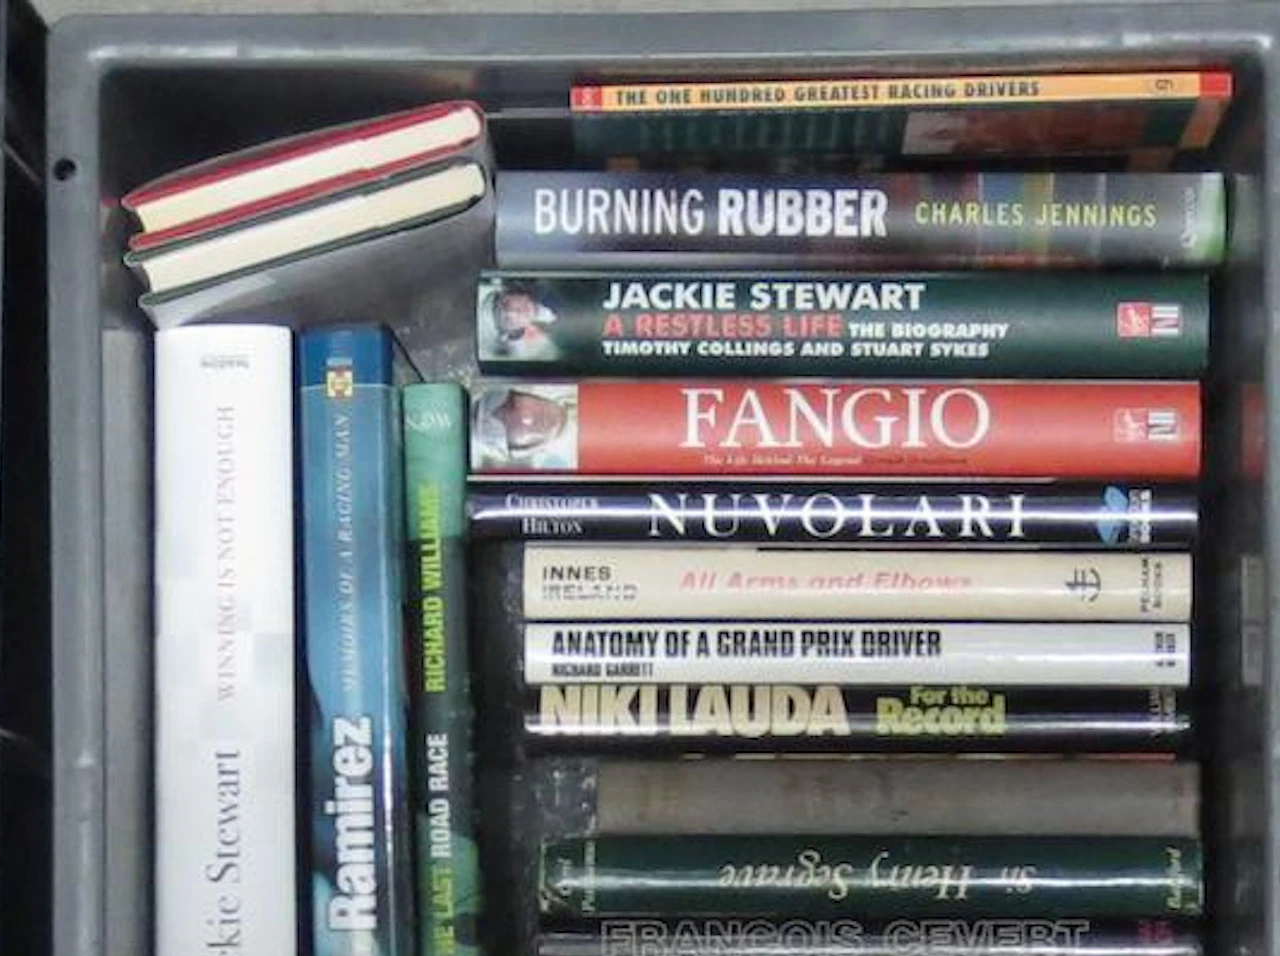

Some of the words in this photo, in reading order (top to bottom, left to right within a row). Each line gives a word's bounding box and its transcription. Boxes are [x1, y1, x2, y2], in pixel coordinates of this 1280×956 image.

[616, 87, 648, 103] THE
[656, 87, 693, 103] ONE
[700, 85, 787, 103] HUNDRED
[796, 84, 880, 101] GREATEST
[889, 82, 956, 99] RACING
[965, 81, 1040, 98] DRIVERS
[534, 190, 705, 237] BURNING
[718, 190, 888, 237] RUBBER
[915, 200, 1024, 227] CHARLES
[1033, 200, 1157, 228] JENNINGS
[602, 283, 734, 310] JACKIE
[750, 283, 925, 310] STEWART
[602, 342, 692, 356] TIMOTHY
[698, 342, 794, 358] COLLINGS
[801, 342, 846, 358] AND
[851, 342, 925, 358] STUART
[930, 342, 989, 358] SYKES
[679, 388, 990, 450] FANGIO
[648, 494, 1026, 540] NUVOLARI
[552, 631, 657, 658] ANATOMY
[665, 631, 691, 657] OF
[695, 631, 710, 657] A
[717, 631, 794, 657] GRAND
[801, 630, 854, 657] PRIX
[861, 631, 942, 657] DRIVER
[539, 685, 658, 735] NIKI
[669, 684, 851, 736] LAUDA
[208, 749, 241, 884] Stewart
[327, 714, 378, 933] Ramirez
